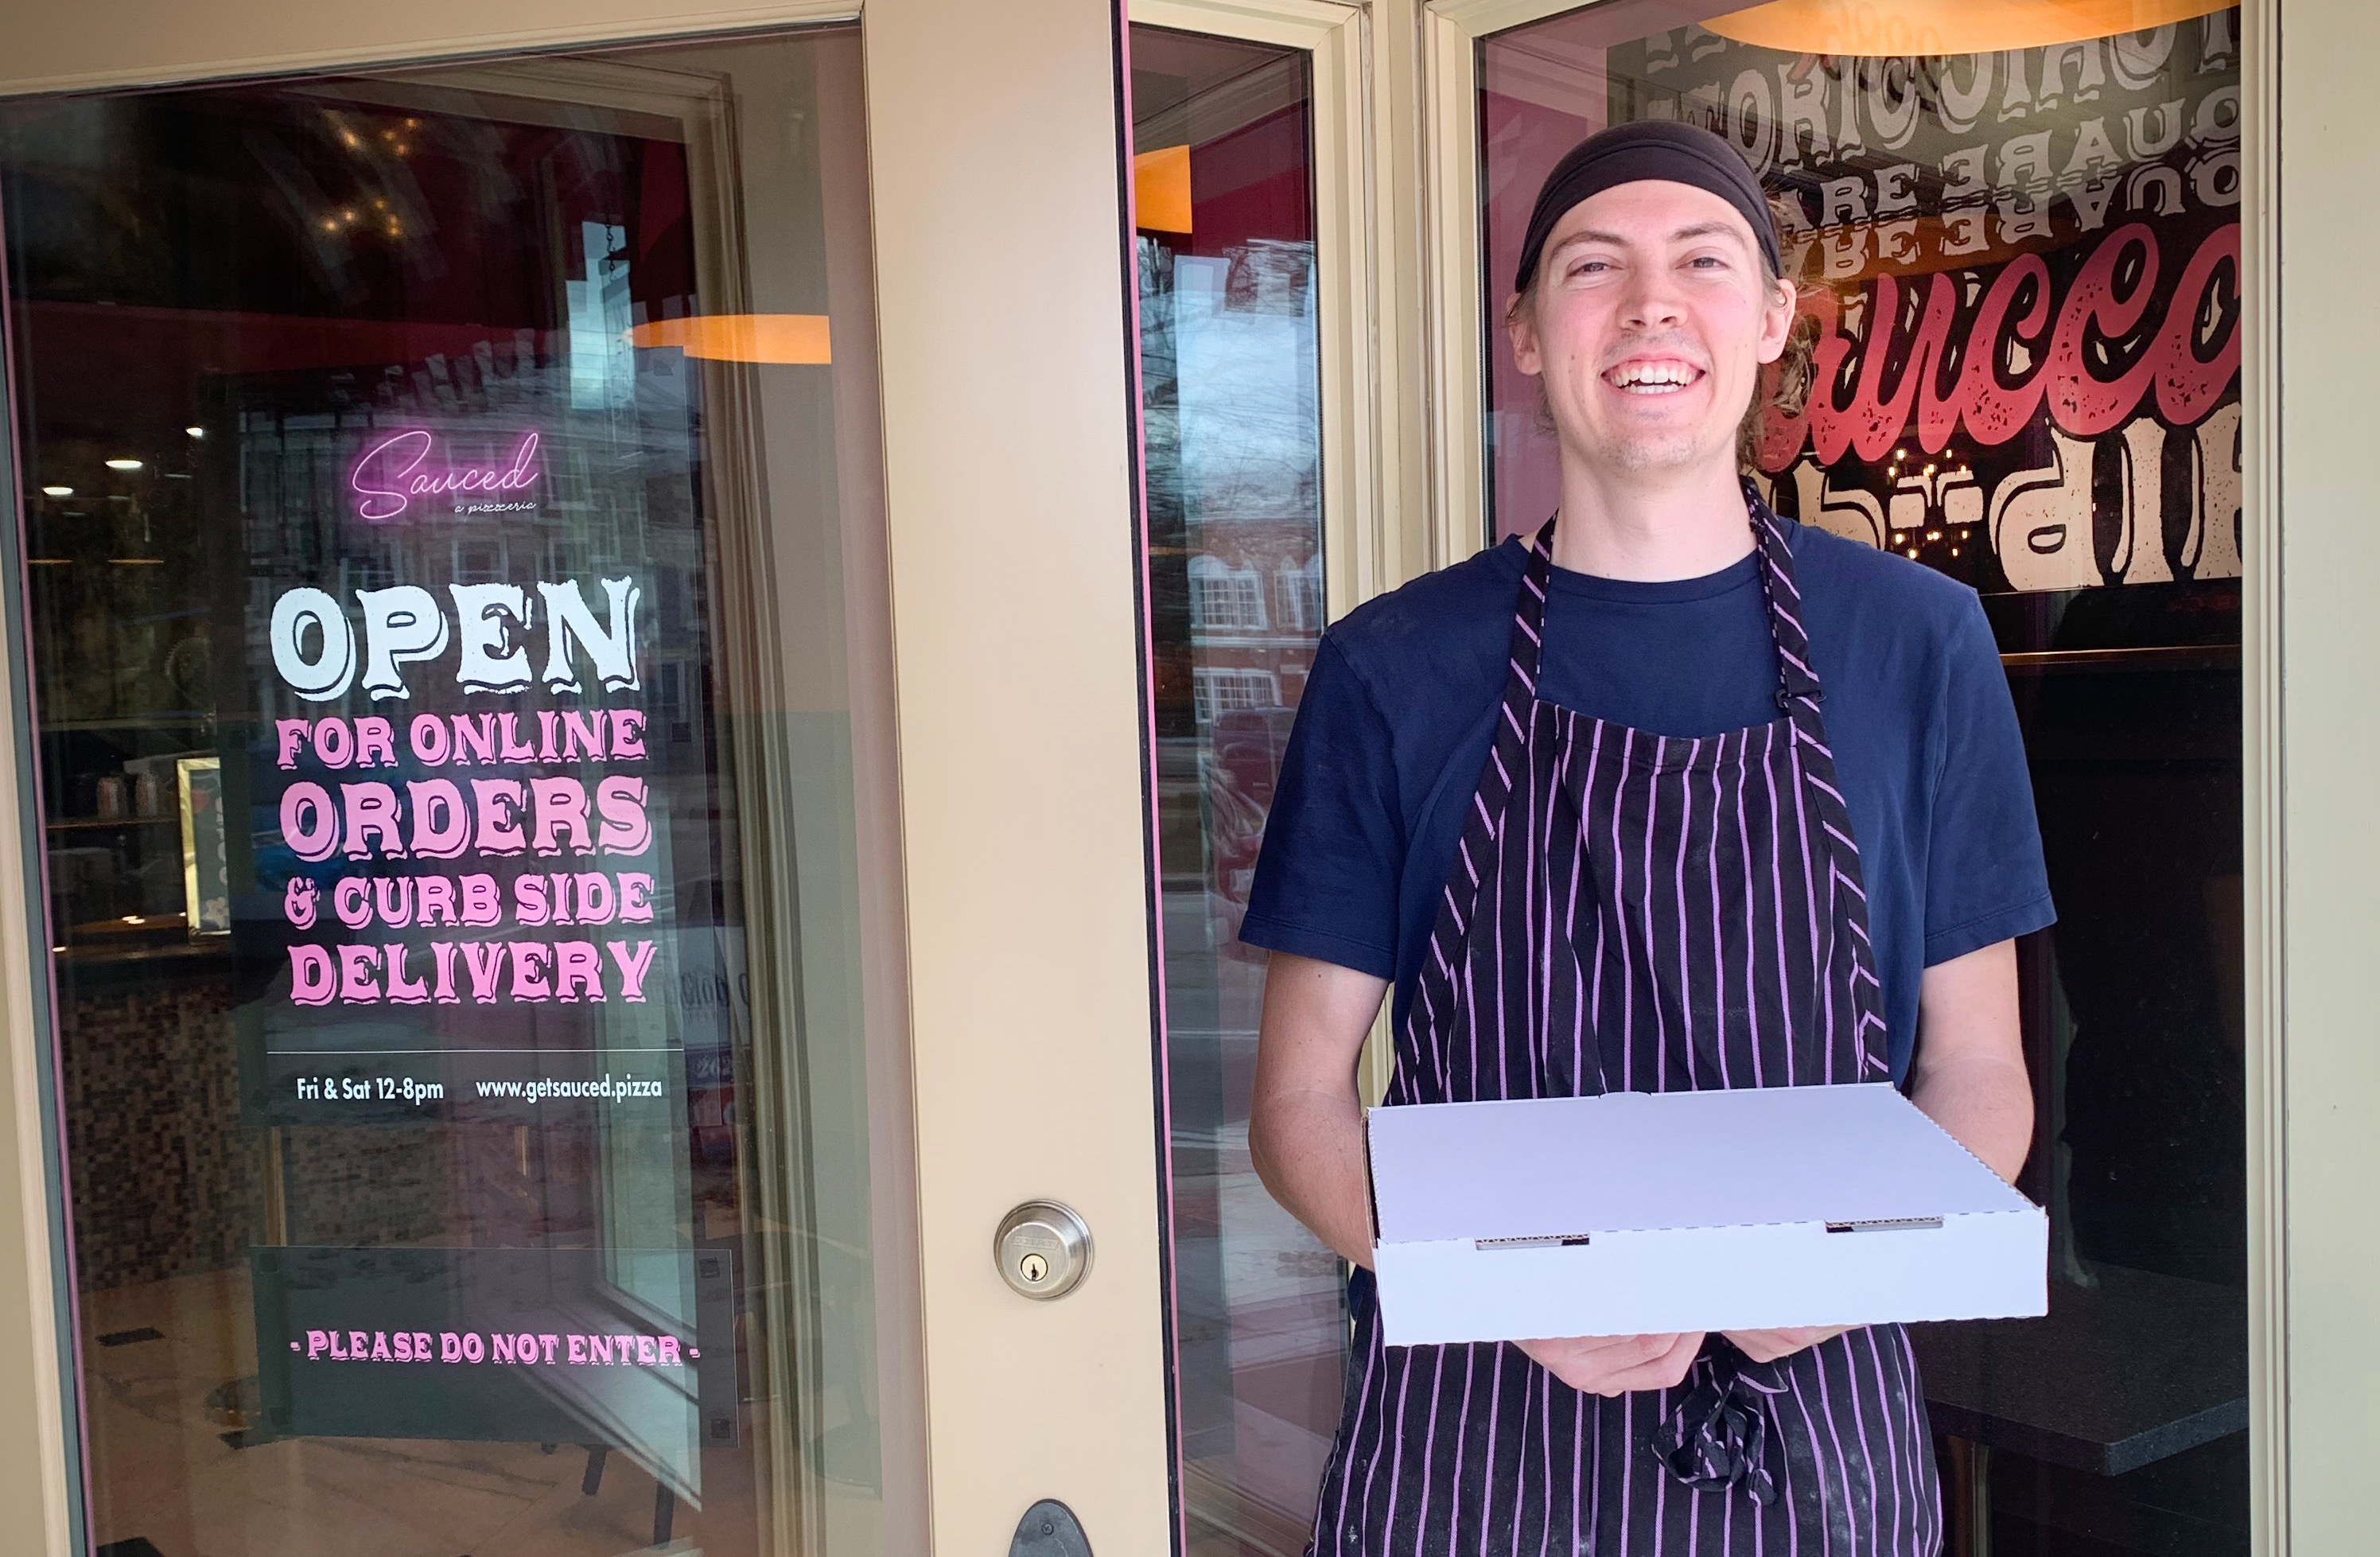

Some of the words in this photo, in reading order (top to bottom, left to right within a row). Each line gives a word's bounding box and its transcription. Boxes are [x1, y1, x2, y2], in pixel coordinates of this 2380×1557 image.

[352, 430, 539, 520] Sauced
[464, 501, 537, 522] pizzeria
[270, 575, 640, 702] OPEN
[276, 717, 399, 770] FOR
[410, 709, 649, 767] ONLINE
[279, 775, 652, 862] ORDERS
[284, 877, 321, 929] &
[334, 873, 502, 930] CURB
[514, 872, 655, 927] SIDE
[287, 941, 658, 1006] DELIVERY
[297, 1076, 319, 1100] Fri
[324, 1077, 339, 1100] &
[342, 1077, 371, 1100] Sat
[376, 1076, 444, 1106] 12-8pm
[476, 1072, 663, 1104] www.getsauced.pizza
[306, 1329, 433, 1361] PLEASE
[440, 1332, 484, 1364] DO
[492, 1333, 559, 1365] NOT
[566, 1333, 683, 1366] ENTER
